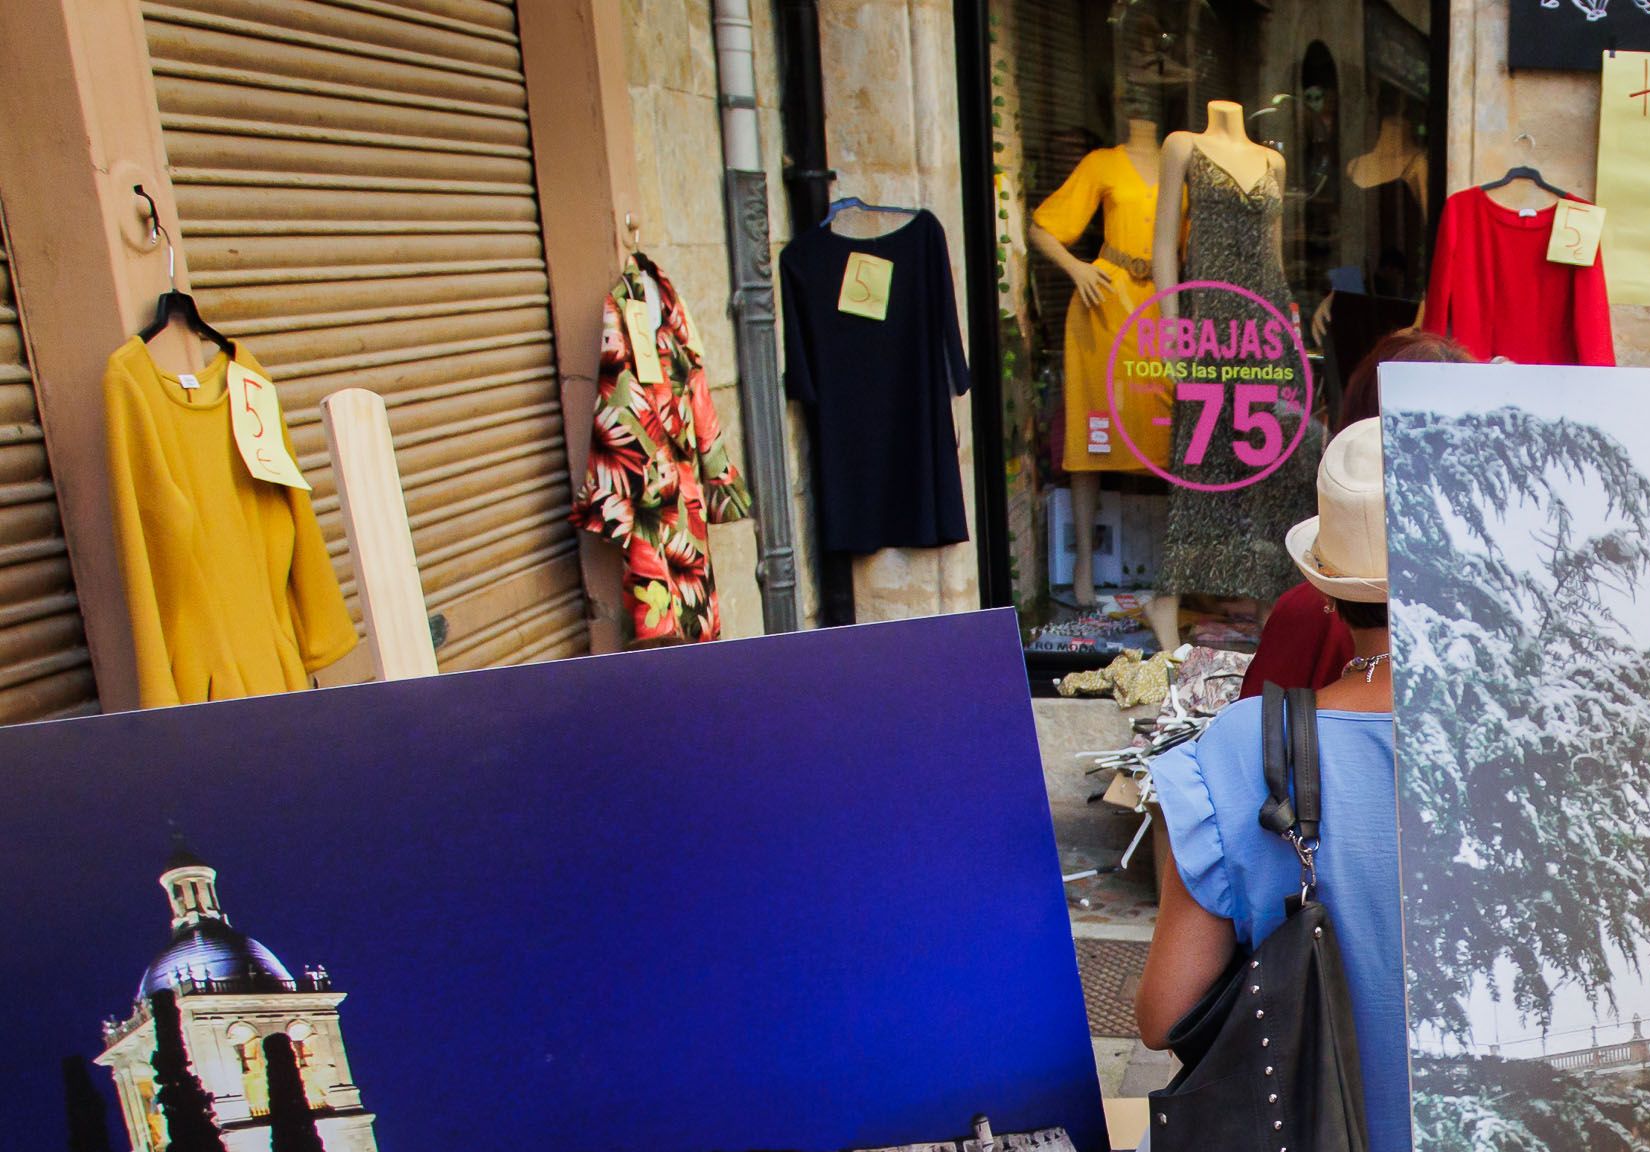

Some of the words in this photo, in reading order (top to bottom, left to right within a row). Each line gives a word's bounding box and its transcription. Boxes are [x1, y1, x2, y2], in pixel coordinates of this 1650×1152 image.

[1563, 206, 1590, 248] 5
[1137, 318, 1284, 360] REBAJAS
[1124, 361, 1188, 379] TODAS
[1192, 362, 1217, 379] las
[1221, 364, 1294, 382] prendas
[243, 377, 264, 438] 5
